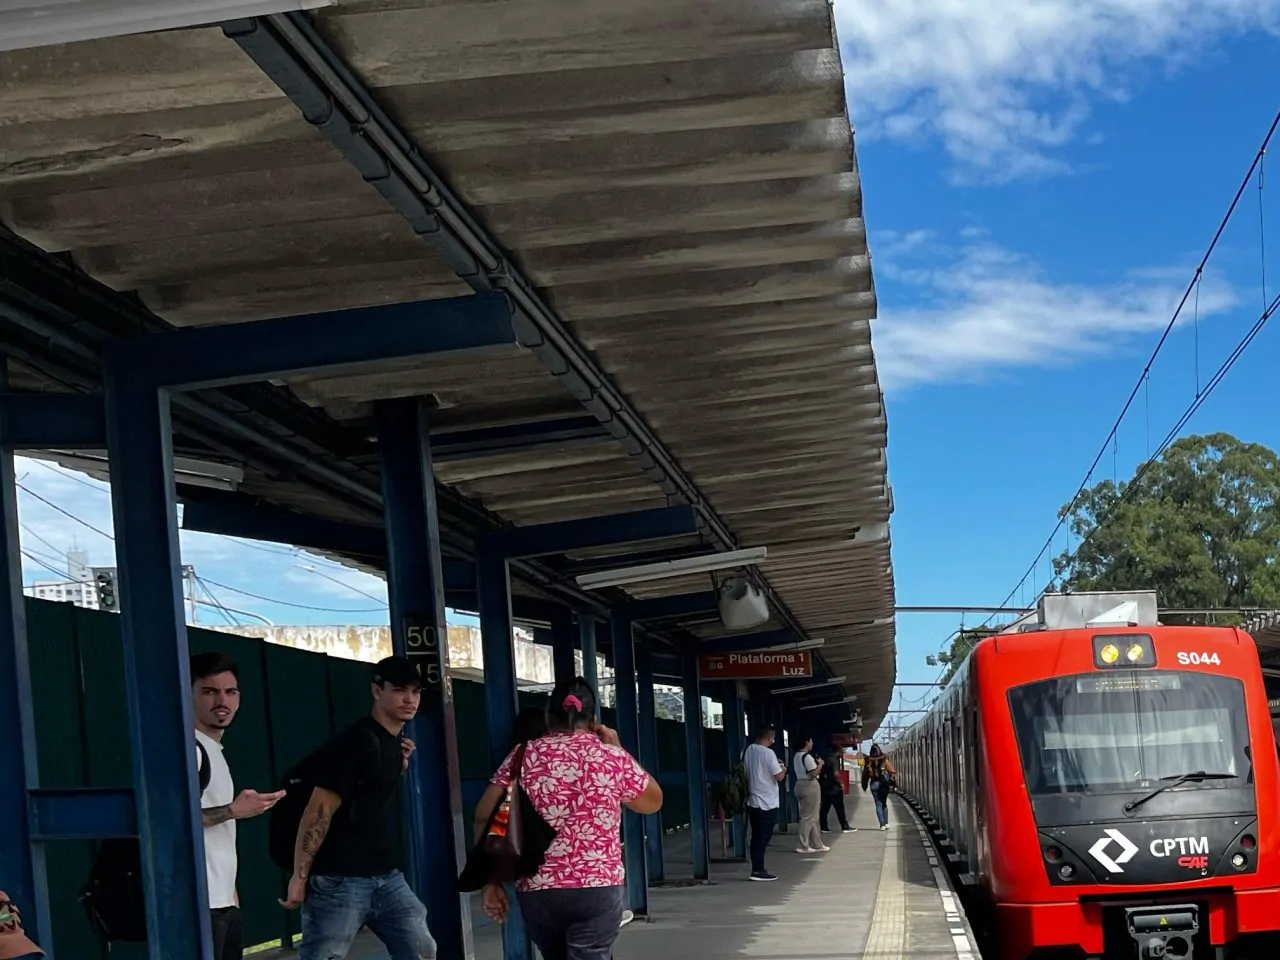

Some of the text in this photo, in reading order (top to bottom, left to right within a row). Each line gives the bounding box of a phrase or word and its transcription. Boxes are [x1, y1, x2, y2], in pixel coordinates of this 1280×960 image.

[407, 626, 437, 647] 50
[729, 653, 796, 665] Plataforma
[798, 652, 805, 663] 1
[1176, 651, 1222, 666] S044
[782, 665, 805, 677] Luz
[1149, 836, 1210, 858] CPTM
[1177, 855, 1209, 869] CAF
